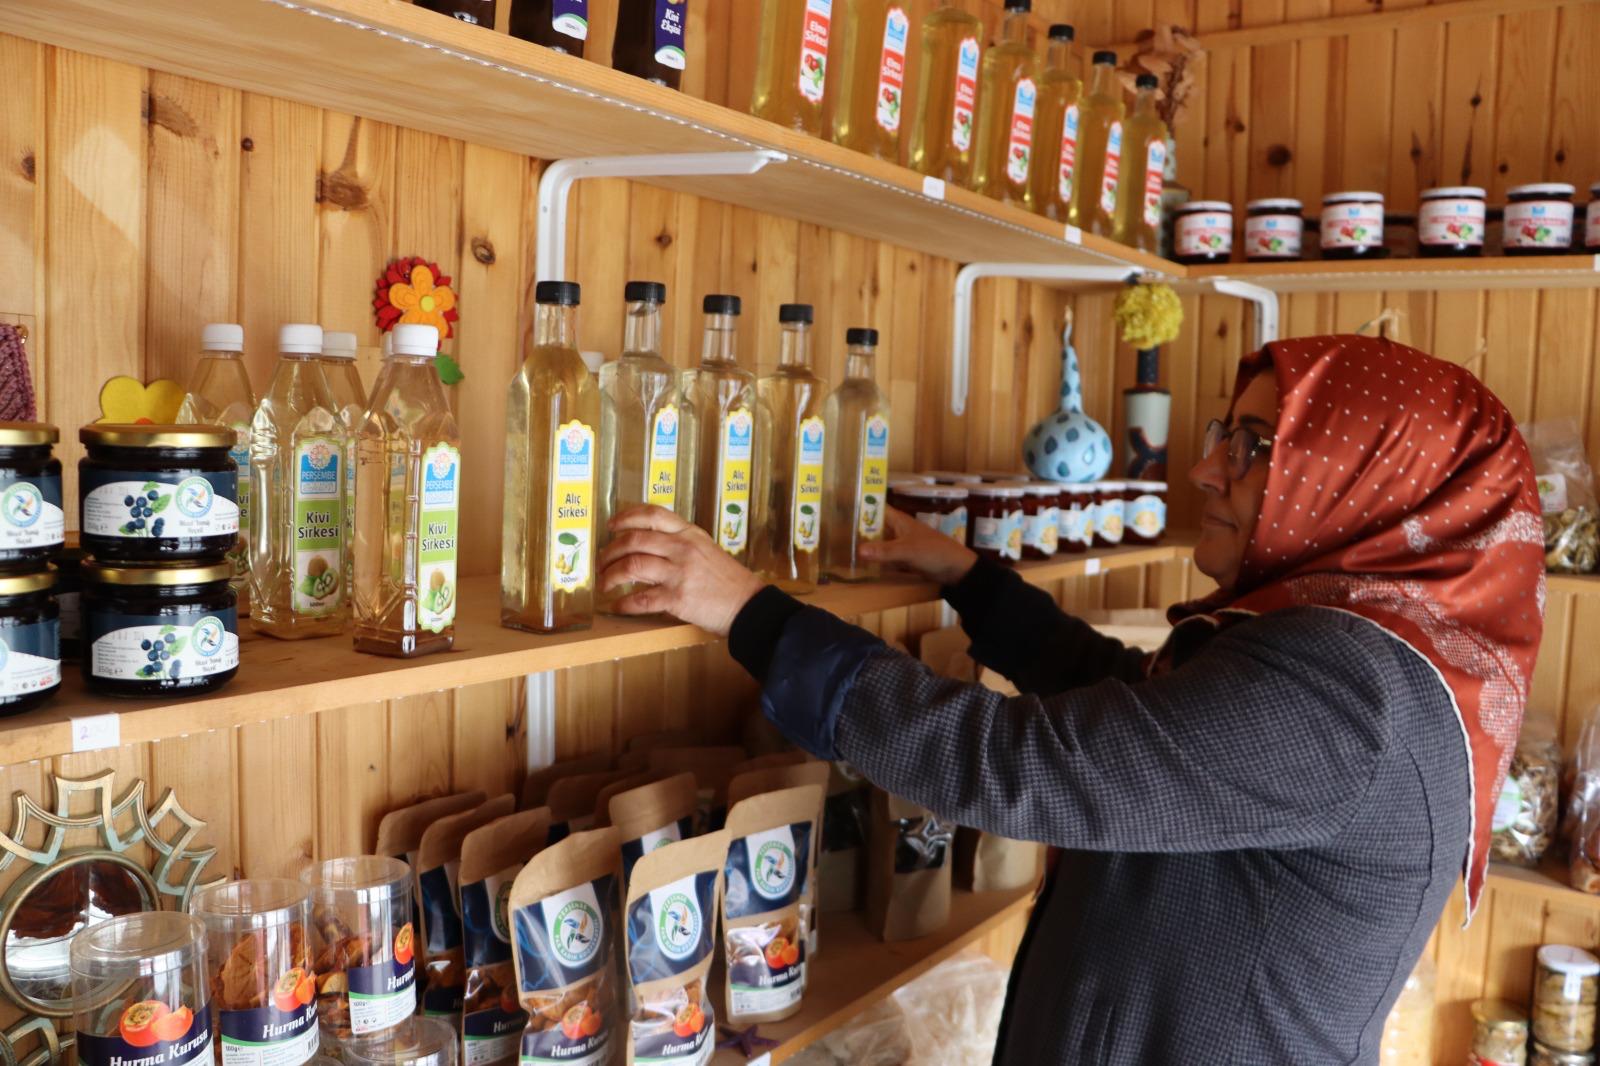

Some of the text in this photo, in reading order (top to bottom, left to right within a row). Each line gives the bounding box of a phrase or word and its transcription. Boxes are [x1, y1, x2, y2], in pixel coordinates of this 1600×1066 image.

[565, 493, 581, 504] Alıç
[306, 511, 330, 524] Kivi
[558, 505, 588, 518] Sirkesi
[298, 525, 339, 539] Sirkesi
[428, 523, 448, 536] Kivi
[422, 536, 454, 551] Sirkesi
[262, 1015, 304, 1039] Hurma
[168, 1028, 209, 1060] Kurusu
[550, 1043, 586, 1057] Hurma
[662, 1040, 695, 1056] Hurma
